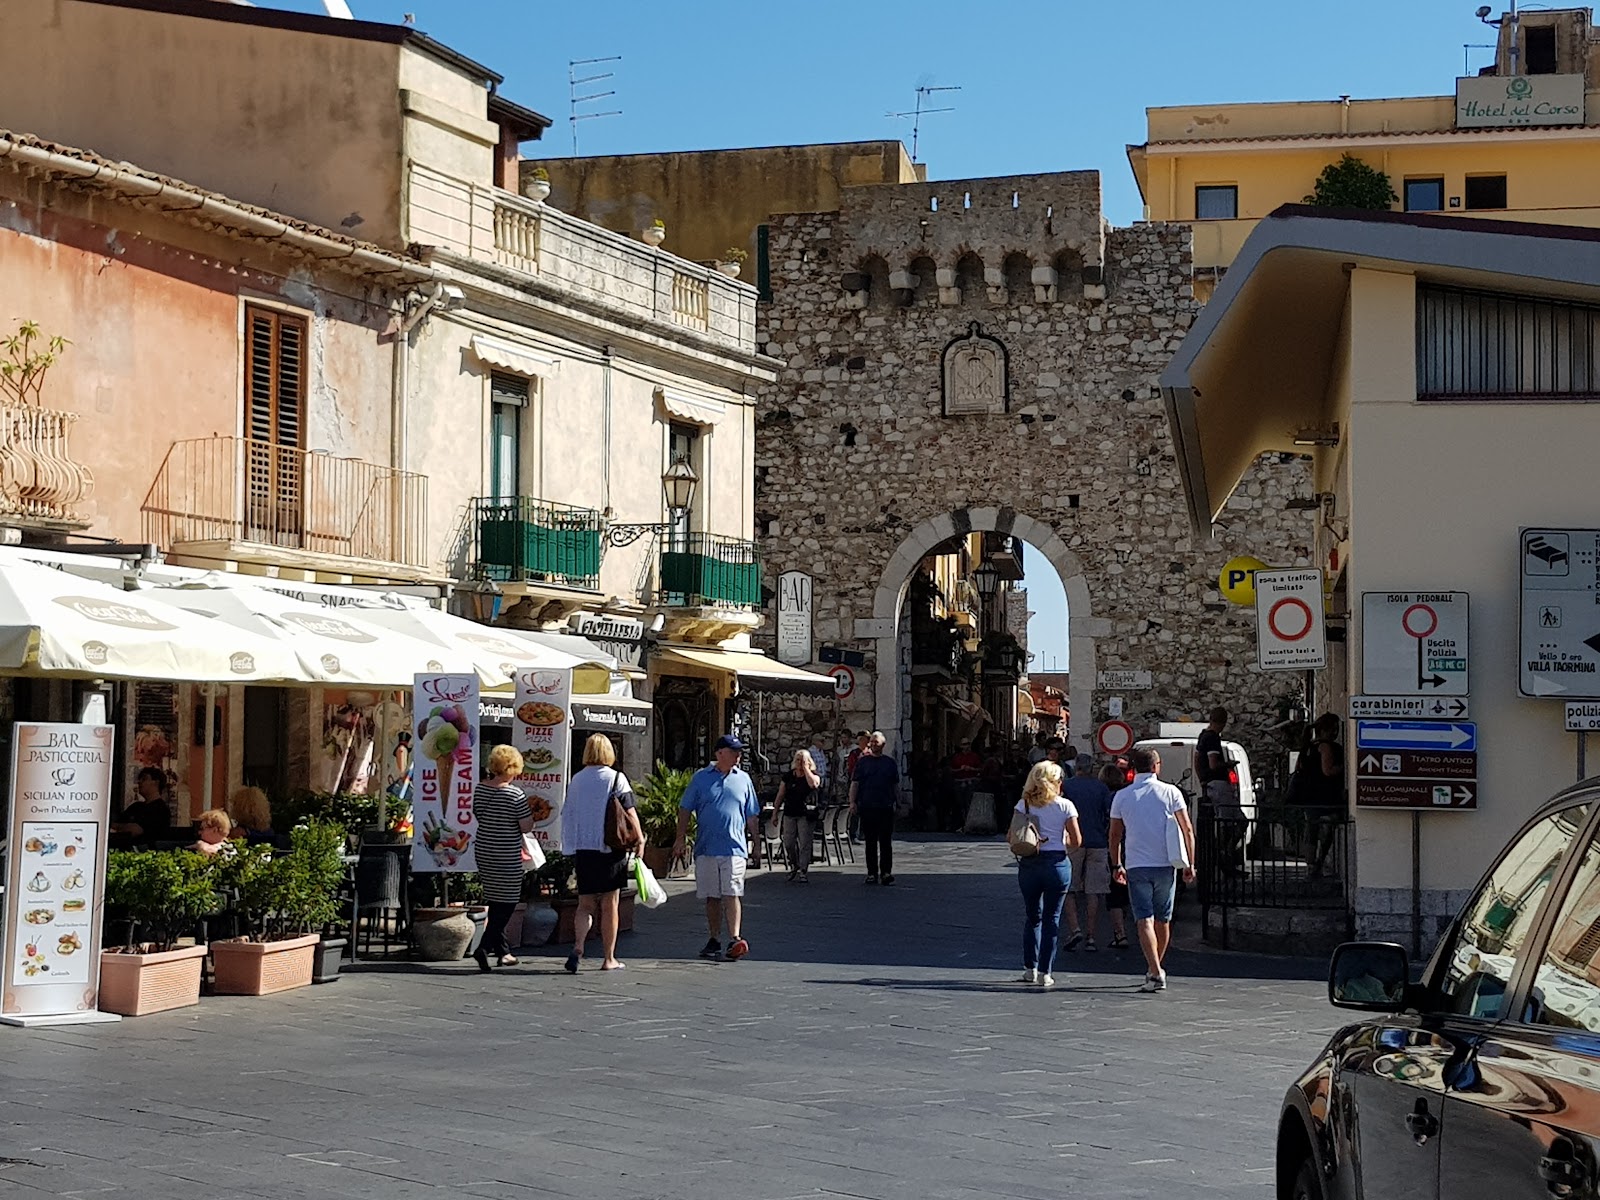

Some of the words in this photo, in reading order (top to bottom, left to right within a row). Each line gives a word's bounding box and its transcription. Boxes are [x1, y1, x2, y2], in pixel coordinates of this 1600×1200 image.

[1461, 101, 1506, 117] Hotel
[1510, 105, 1529, 115] del
[1534, 102, 1579, 115] Corso
[1288, 574, 1317, 582] traffico
[780, 577, 810, 612] BAR
[1387, 594, 1409, 603] ISOLA
[1417, 594, 1453, 603] PEDONALE
[1427, 639, 1456, 647] Uscita
[1427, 648, 1457, 657] Polizia
[1528, 661, 1551, 671] VILLA
[1553, 661, 1596, 673] TAORMINA
[1352, 699, 1424, 709] carabinieri
[525, 727, 553, 736] PIZZE
[28, 751, 104, 763] PASTICCERIA
[422, 768, 438, 801] ICE
[457, 749, 473, 825] CREAM
[1361, 785, 1382, 793] VILLA
[23, 792, 66, 801] SICILIAN
[70, 792, 98, 801] FOOD
[51, 805, 92, 814] Production
[532, 831, 549, 840] STA
